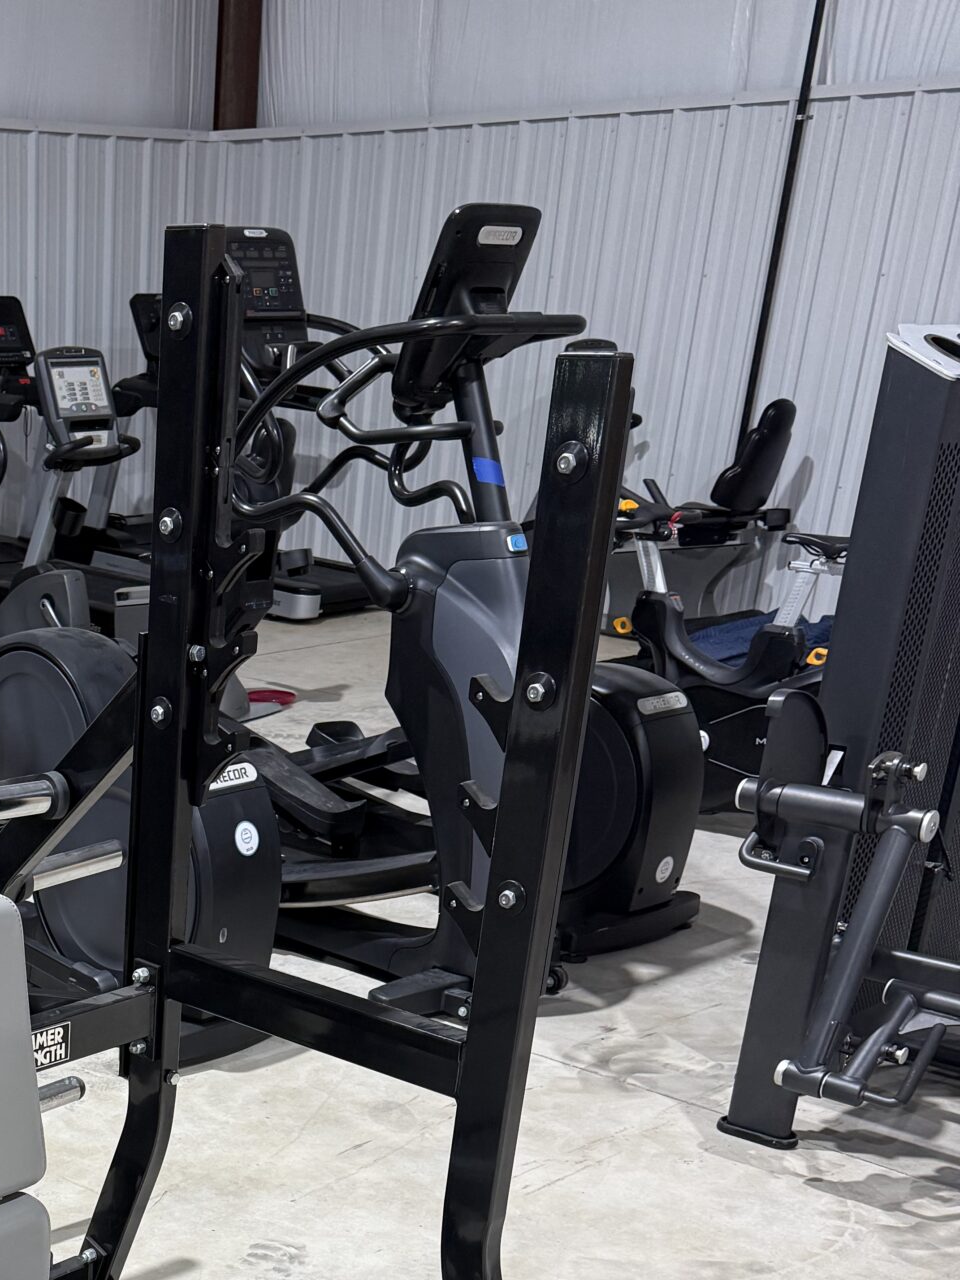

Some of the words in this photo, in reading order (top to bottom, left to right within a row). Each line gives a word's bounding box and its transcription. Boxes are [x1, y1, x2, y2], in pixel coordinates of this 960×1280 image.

[216, 767, 249, 784] ECOR
[32, 1027, 64, 1050] MER
[33, 1042, 66, 1066] NGTH
